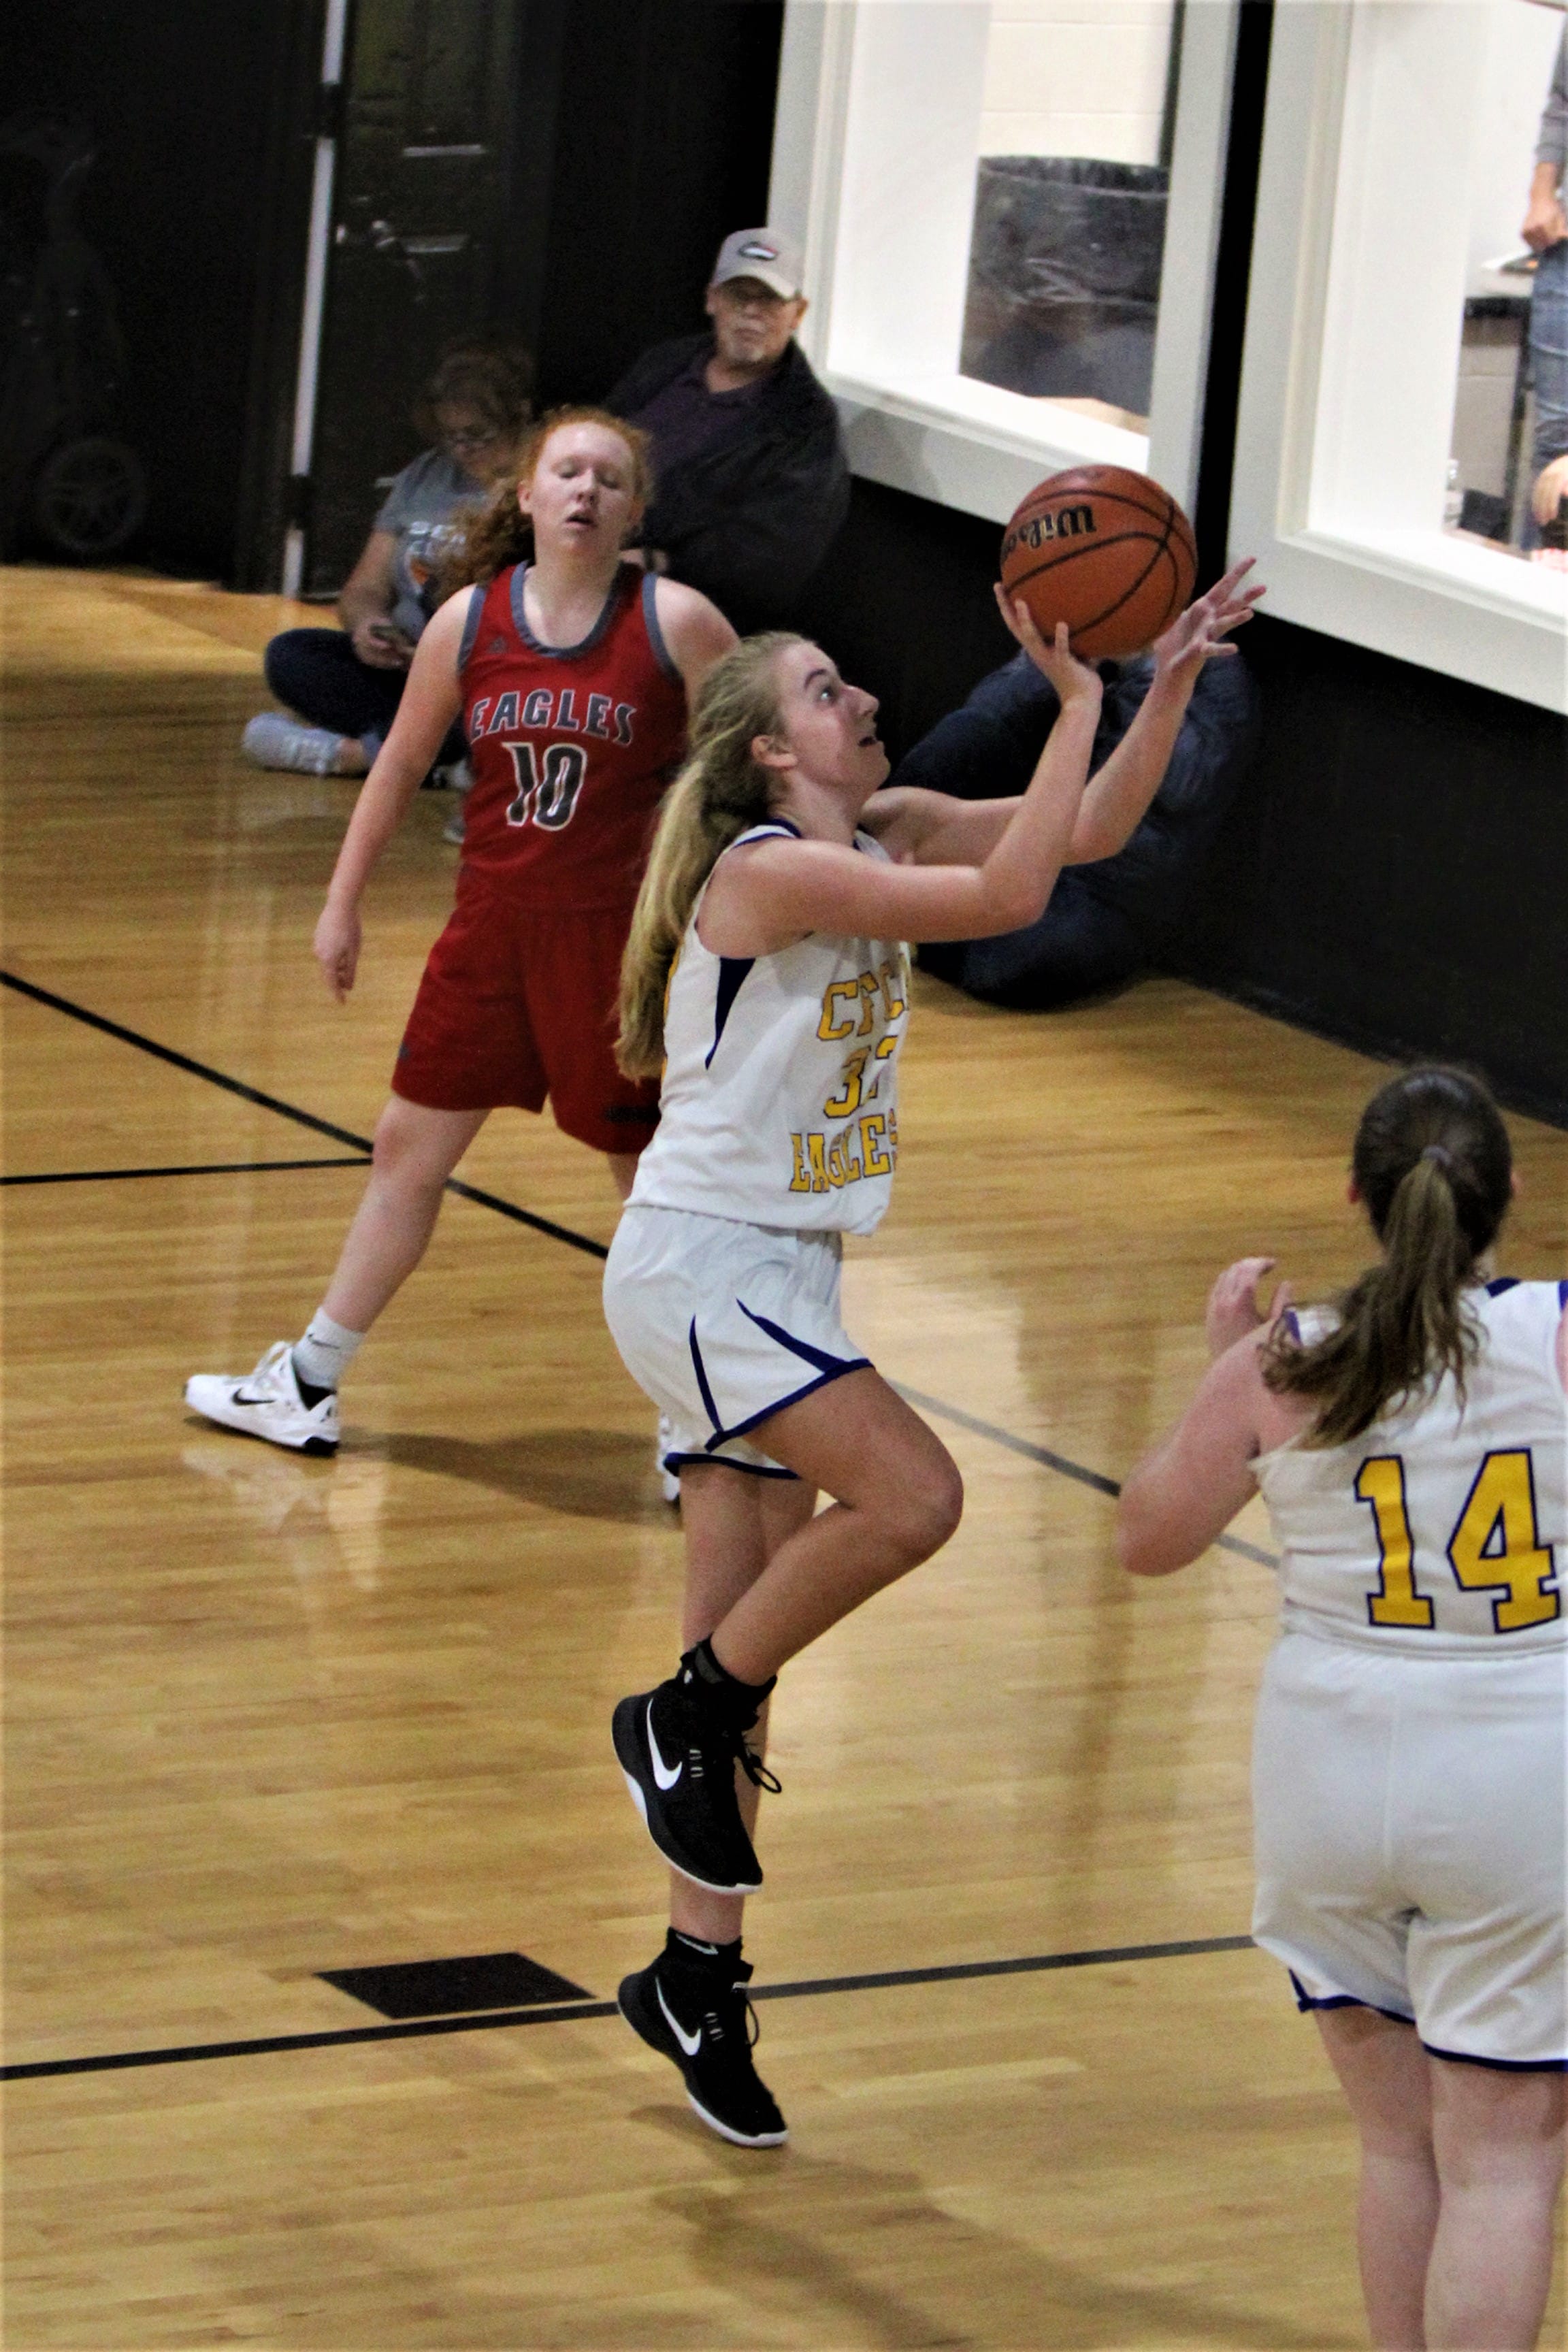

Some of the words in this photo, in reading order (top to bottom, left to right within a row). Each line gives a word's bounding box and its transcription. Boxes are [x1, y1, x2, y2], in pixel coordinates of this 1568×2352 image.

[470, 688, 637, 747] EAGLES
[501, 742, 588, 832] 10
[1353, 1447, 1561, 1634] 14
